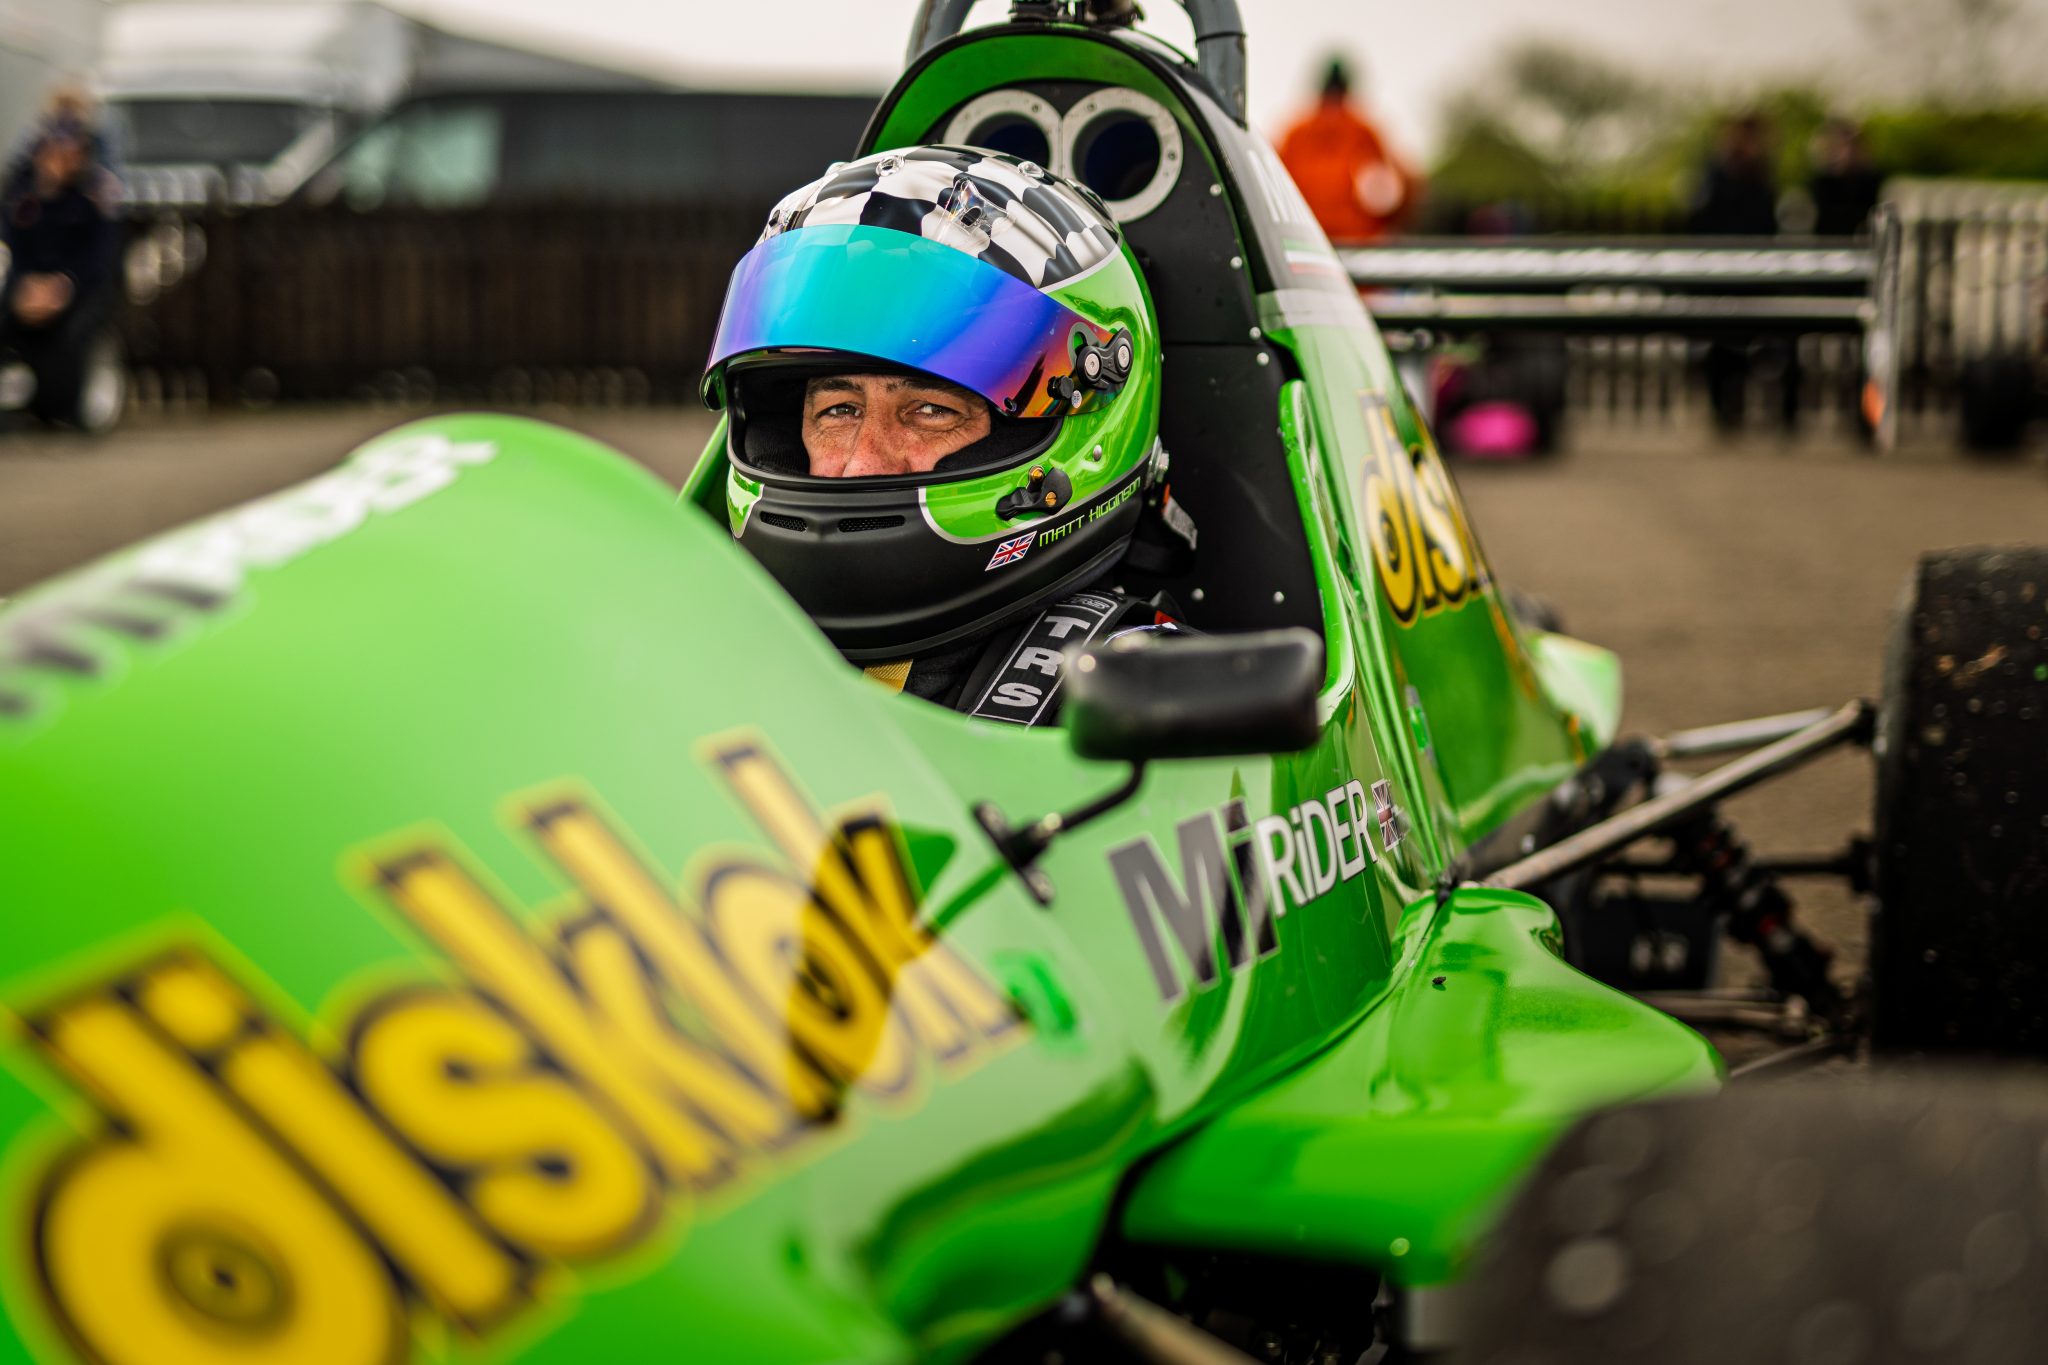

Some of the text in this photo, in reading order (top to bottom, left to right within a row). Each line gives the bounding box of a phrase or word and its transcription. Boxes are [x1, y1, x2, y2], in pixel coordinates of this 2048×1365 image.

[1039, 514, 1085, 547] MATT
[991, 615, 1091, 707] TRS
[12, 733, 1033, 1365] disklok
